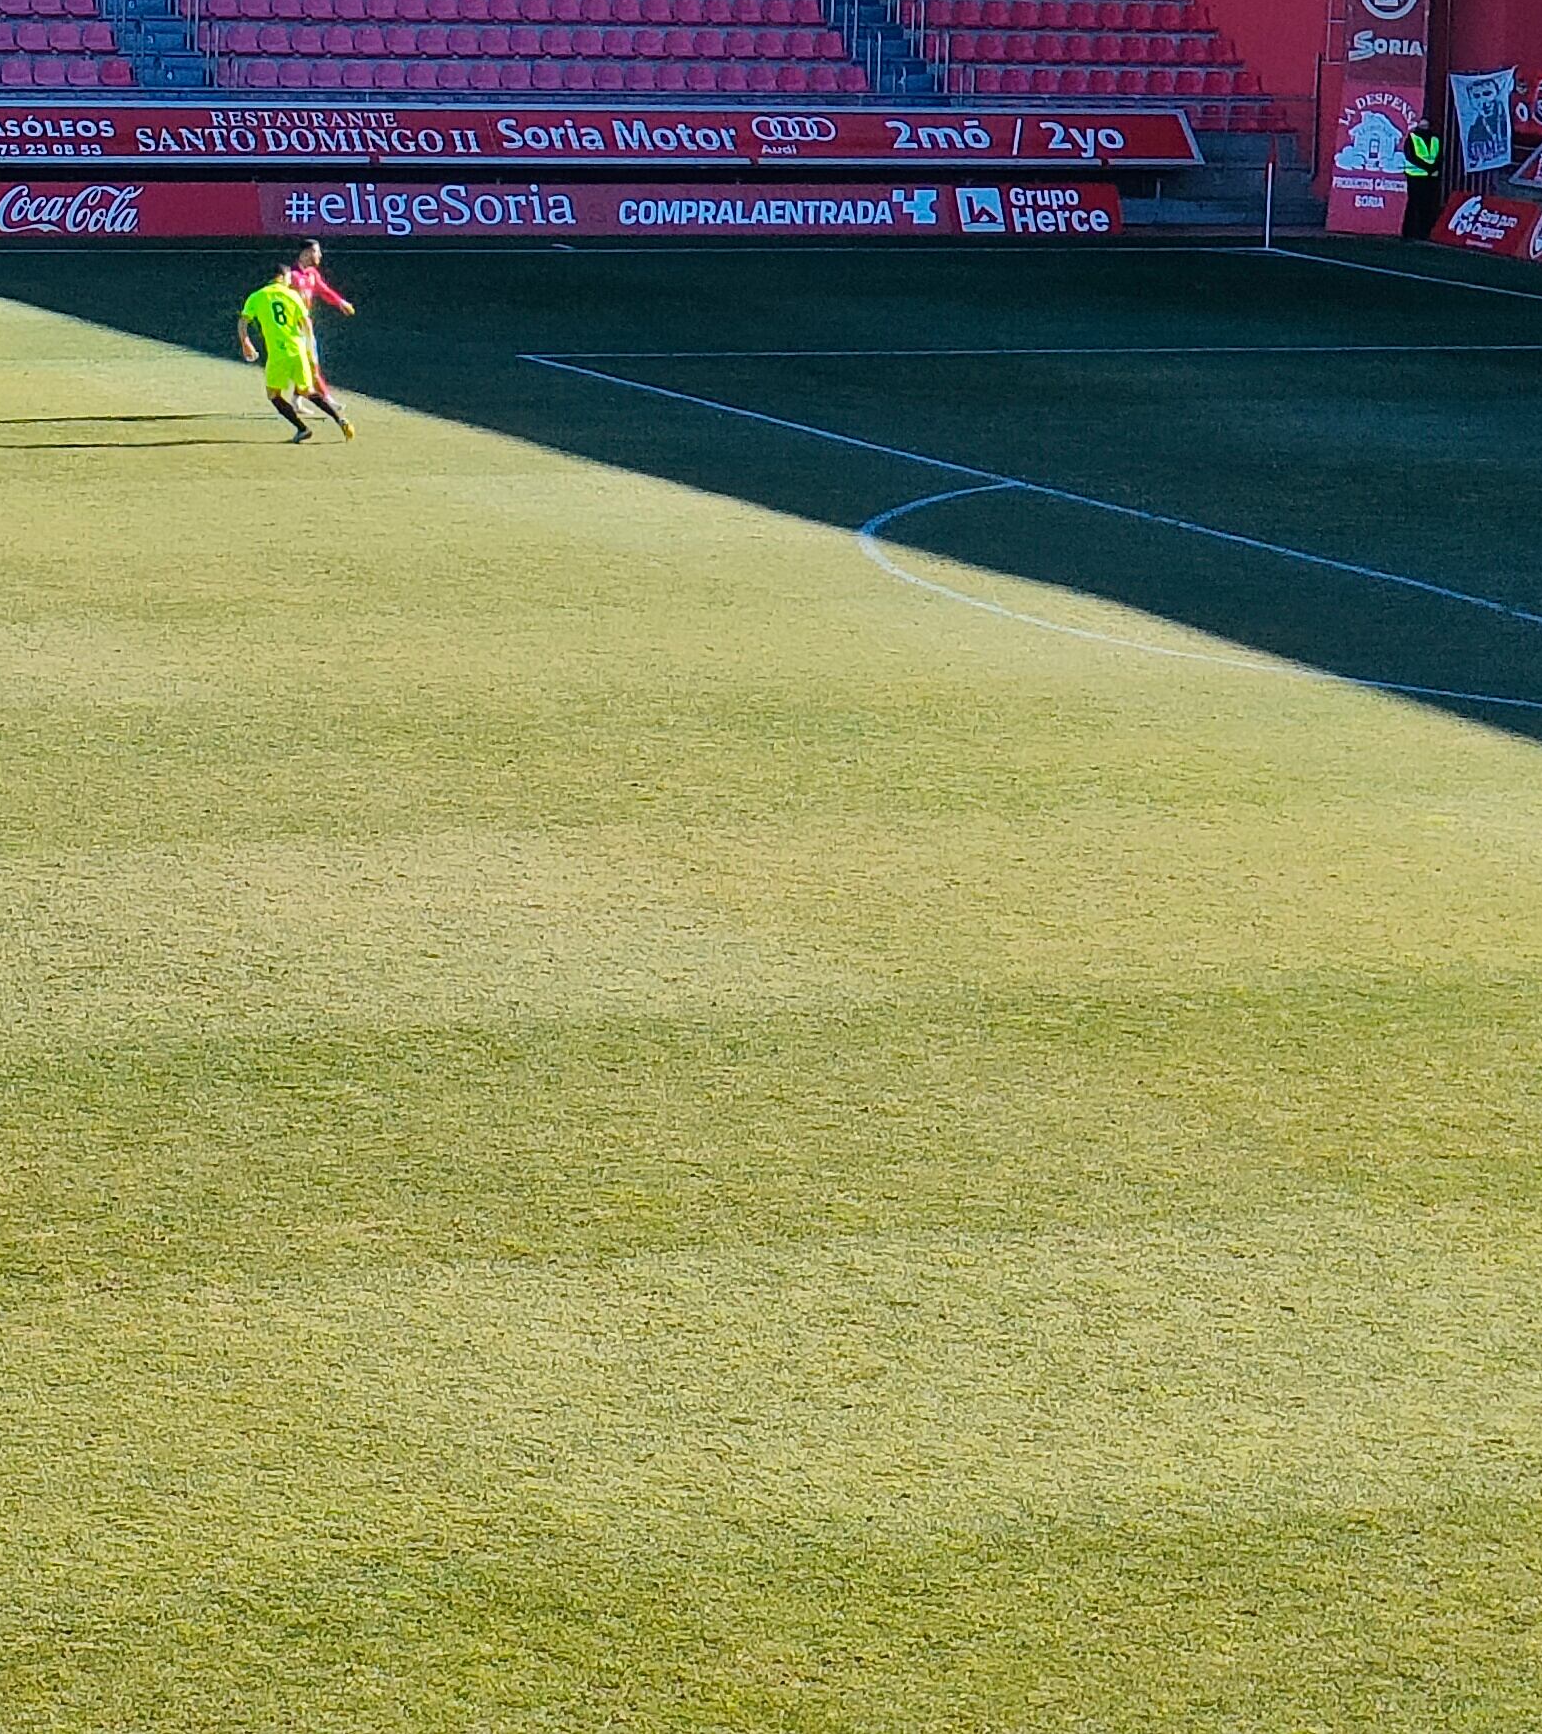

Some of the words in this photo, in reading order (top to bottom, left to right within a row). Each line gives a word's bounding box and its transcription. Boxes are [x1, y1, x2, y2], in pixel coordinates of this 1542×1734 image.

[211, 111, 398, 128] RESTAURANTE
[135, 127, 259, 152] SANTO
[262, 128, 447, 154] DOMINGO
[449, 129, 482, 154] II
[498, 118, 604, 151] Soria
[613, 121, 737, 153] Motor
[1039, 122, 1125, 158] 2yo
[26, 144, 48, 156] 23
[761, 144, 797, 155] Audi
[284, 183, 576, 235] #eligeSoria
[618, 198, 893, 226] COMPRALAENTRADA
[1009, 187, 1080, 210] Grupo
[1011, 207, 1110, 234] Herce
